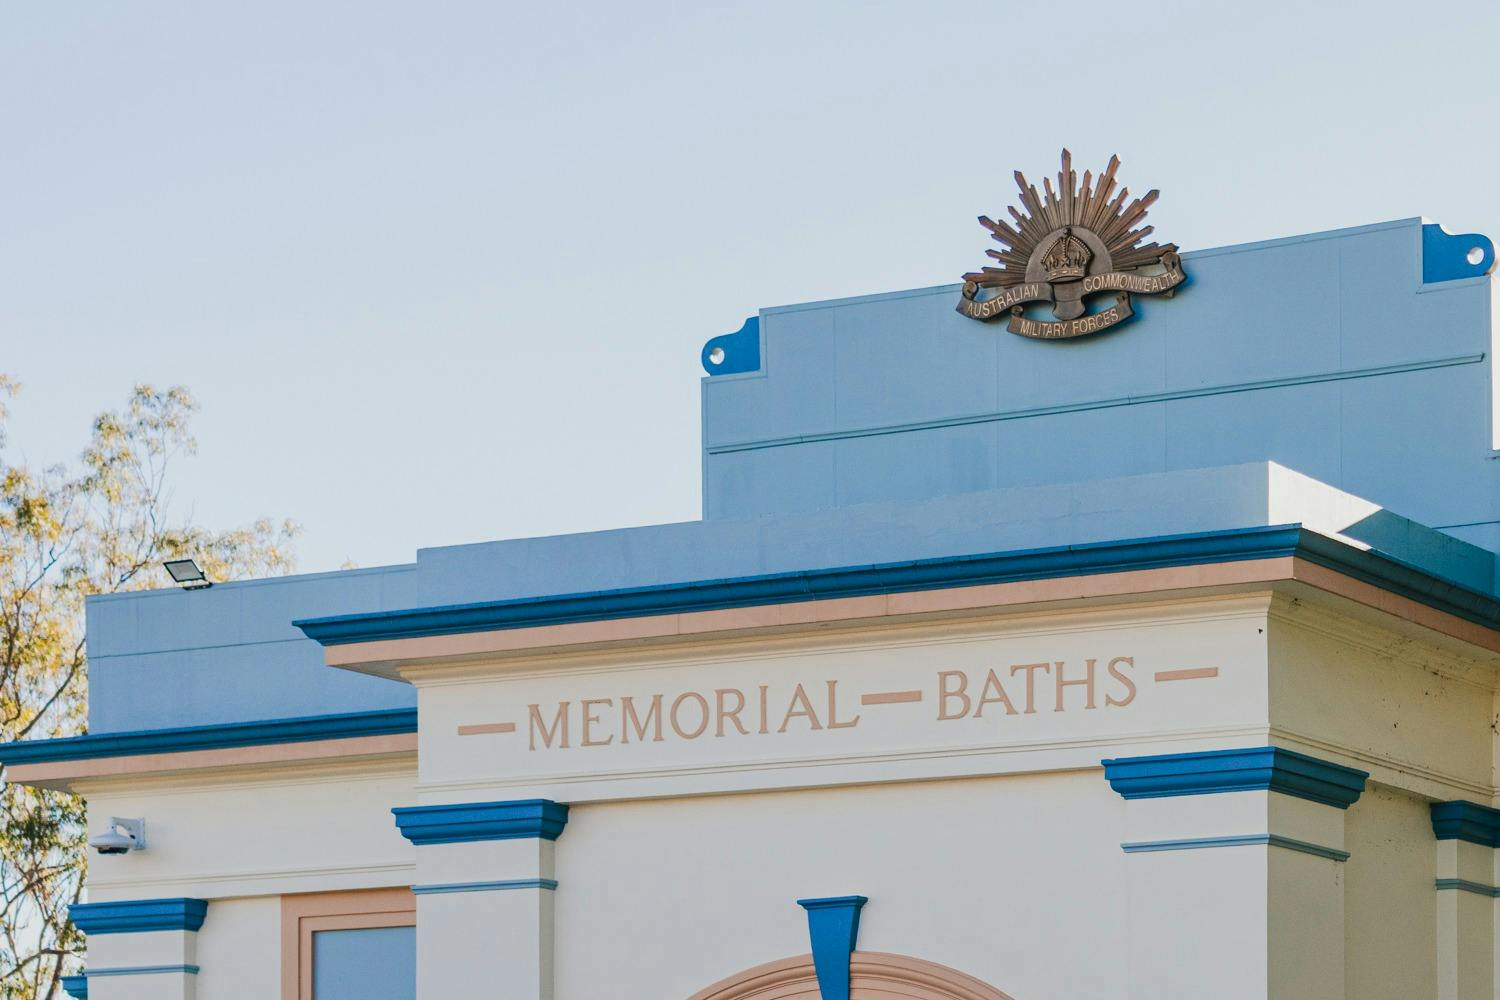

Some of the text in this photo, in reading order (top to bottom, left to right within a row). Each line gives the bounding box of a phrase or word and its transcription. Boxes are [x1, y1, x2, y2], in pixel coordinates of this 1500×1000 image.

[967, 273, 1179, 317] AUSTRALIAN COMMONWEALTH
[1019, 307, 1119, 337] MILITARY FORCES
[527, 656, 1137, 751] MEMORIAL BATHS
